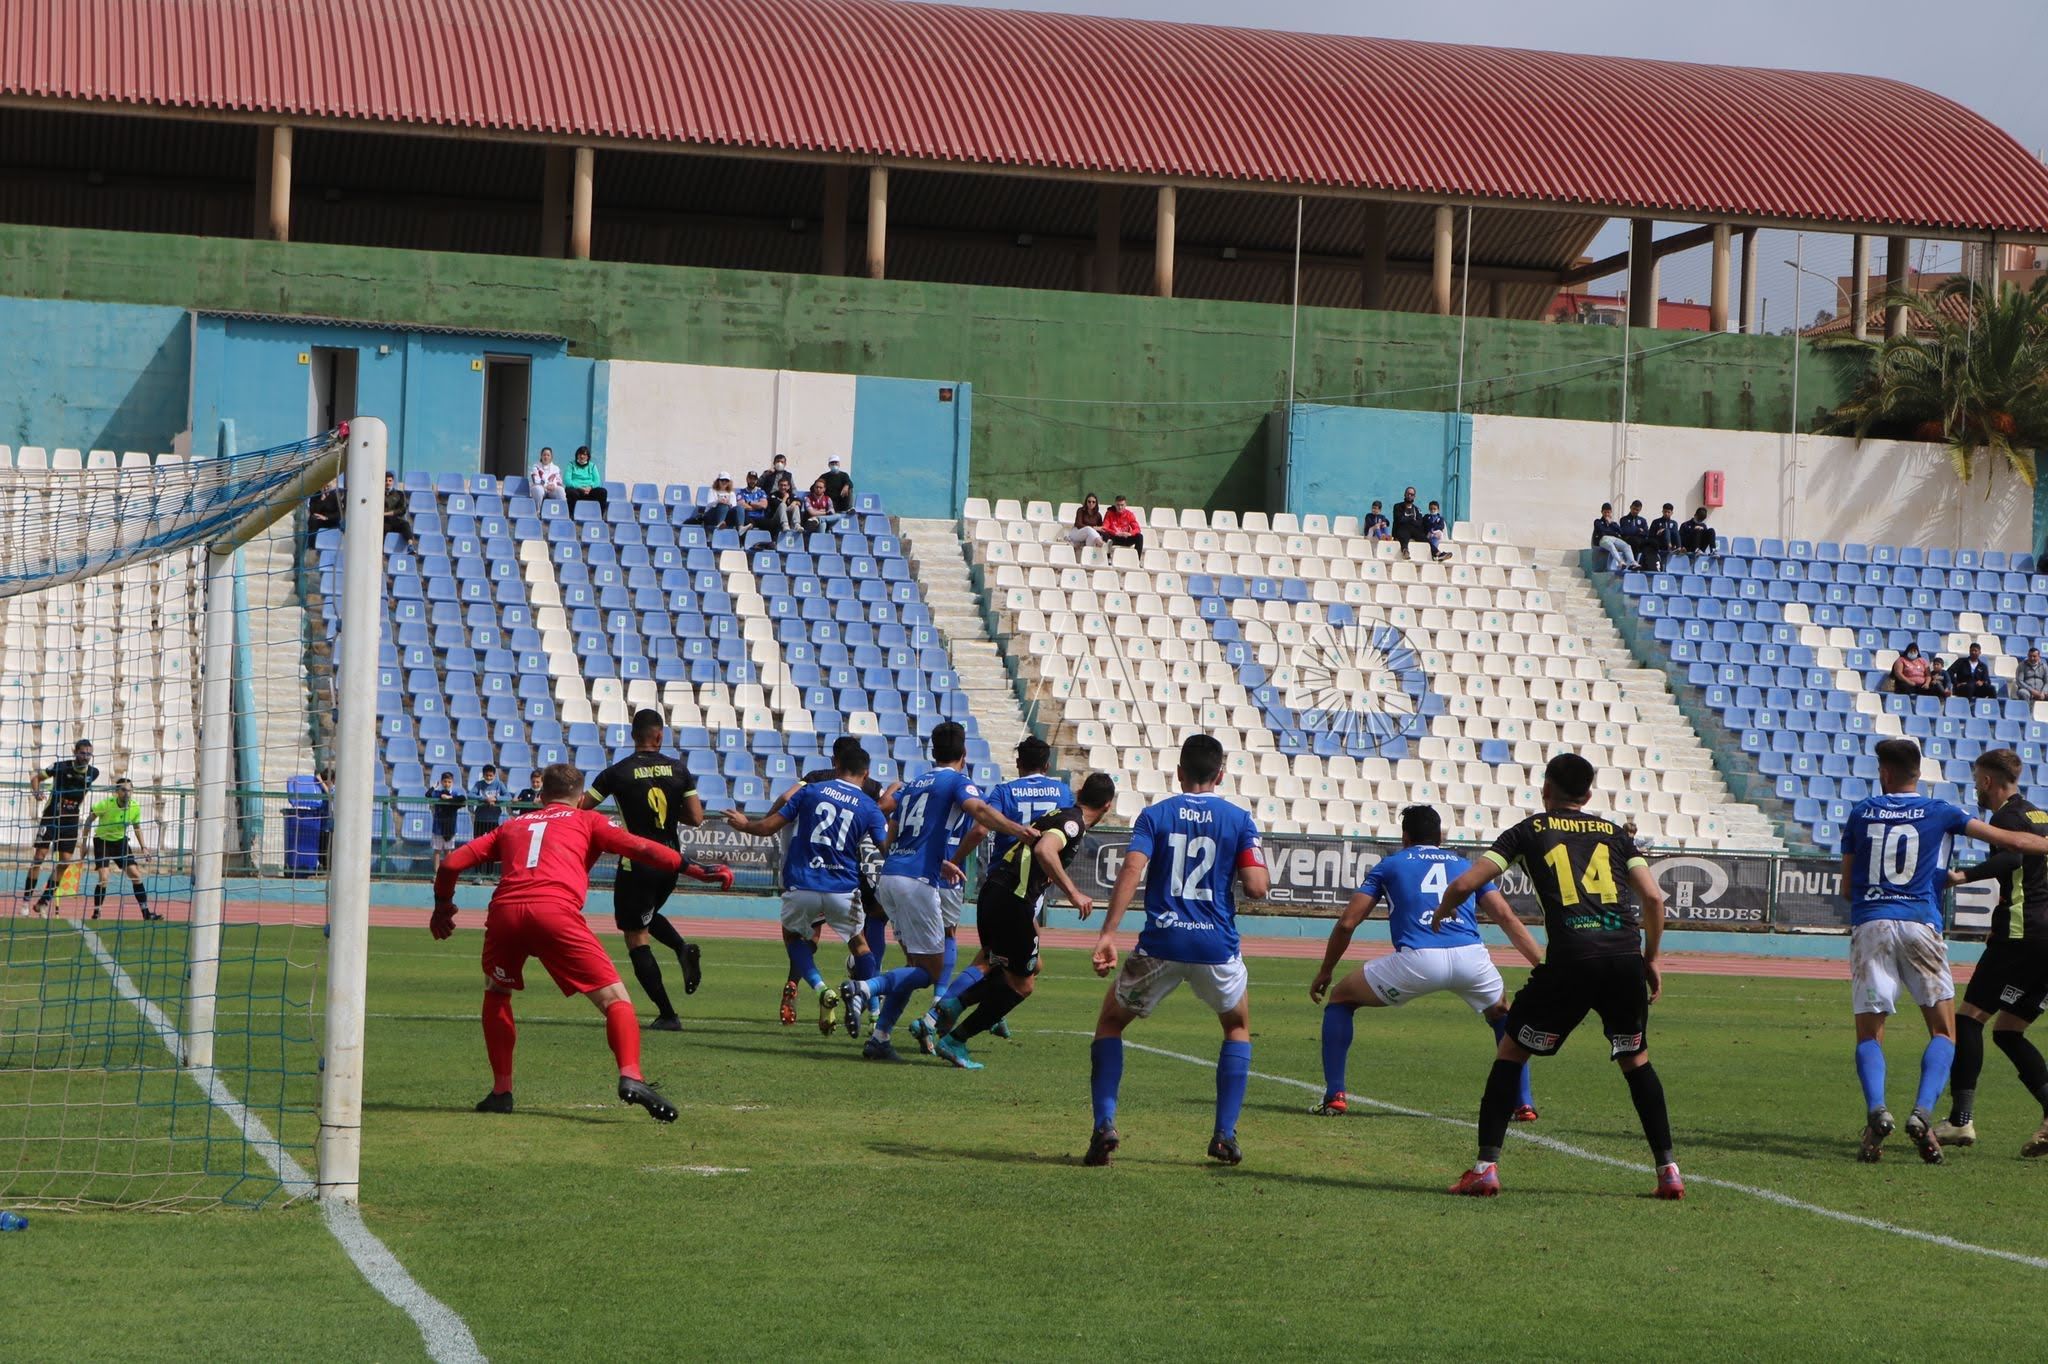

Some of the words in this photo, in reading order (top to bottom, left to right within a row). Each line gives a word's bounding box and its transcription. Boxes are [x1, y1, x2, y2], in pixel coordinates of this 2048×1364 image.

[647, 787, 667, 829] 9
[821, 787, 850, 803] JORDAN
[851, 796, 859, 806] H.
[1011, 786, 1061, 797] CHABBOURA
[810, 801, 855, 851] 21
[898, 792, 930, 837] 14
[1179, 807, 1213, 824] BORJA
[1533, 819, 1546, 832] S.
[1548, 816, 1614, 835] MONTERO
[526, 821, 548, 868] 1
[697, 849, 767, 863] ESPAÑOLA
[1867, 823, 1920, 886] 10
[1168, 832, 1217, 902] 12
[1420, 862, 1448, 904] 4
[1543, 842, 1618, 906] 14
[1173, 920, 1215, 931] serglobin
[1688, 906, 1762, 920] REDES
